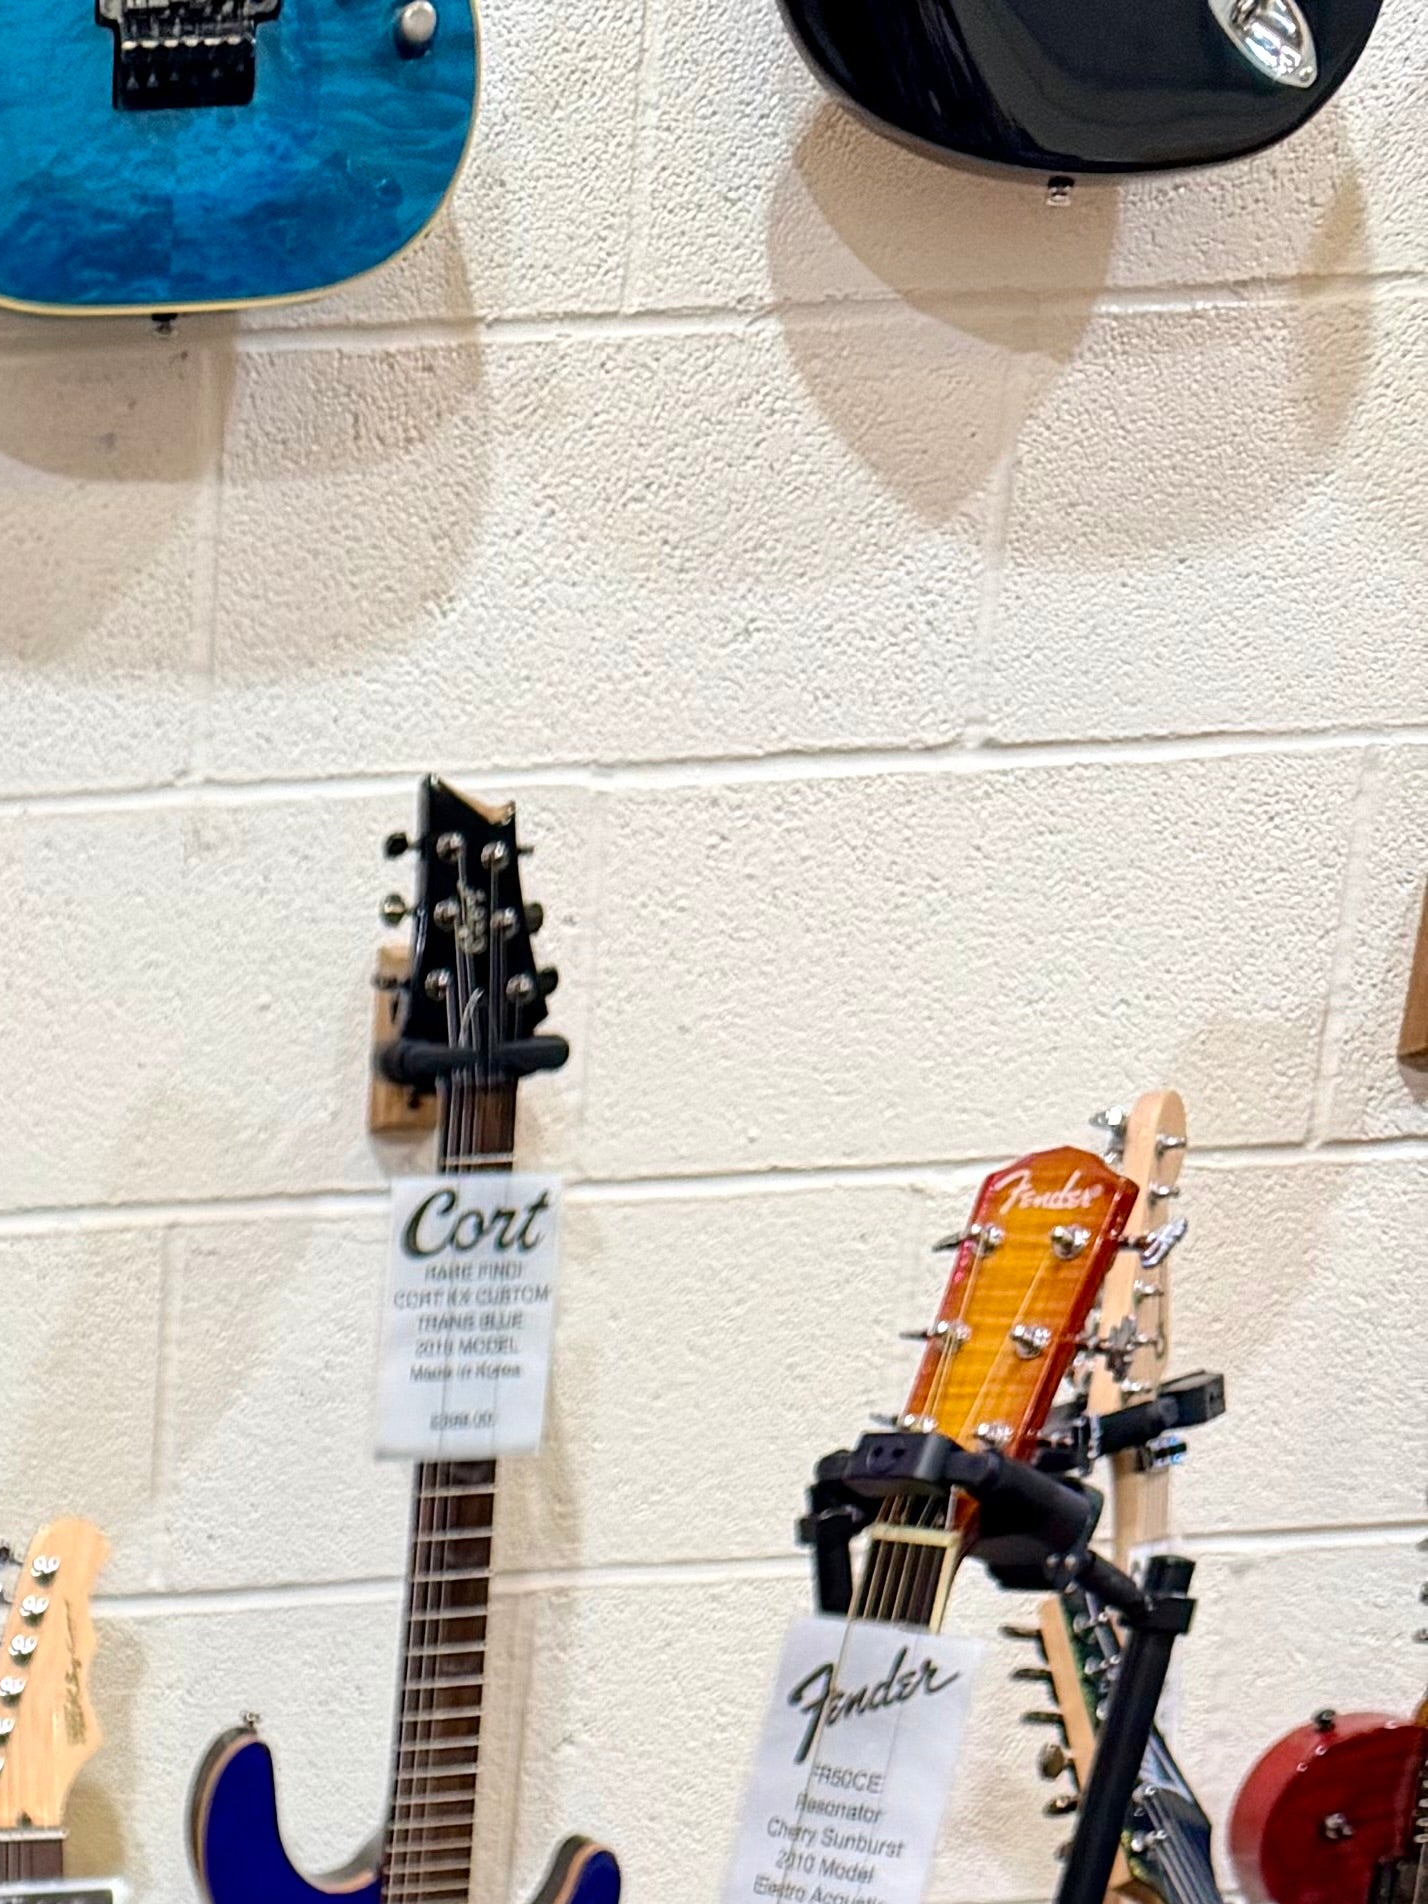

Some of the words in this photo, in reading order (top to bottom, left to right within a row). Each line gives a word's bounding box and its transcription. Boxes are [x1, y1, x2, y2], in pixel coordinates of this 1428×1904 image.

[995, 1168, 1104, 1215] Fender
[401, 1189, 550, 1260] Cort
[458, 1337, 518, 1354] MODEL
[787, 1646, 960, 1765] Fender
[794, 1792, 884, 1824] Resonator
[820, 1827, 904, 1857] Sunburst
[818, 1857, 875, 1885] Model
